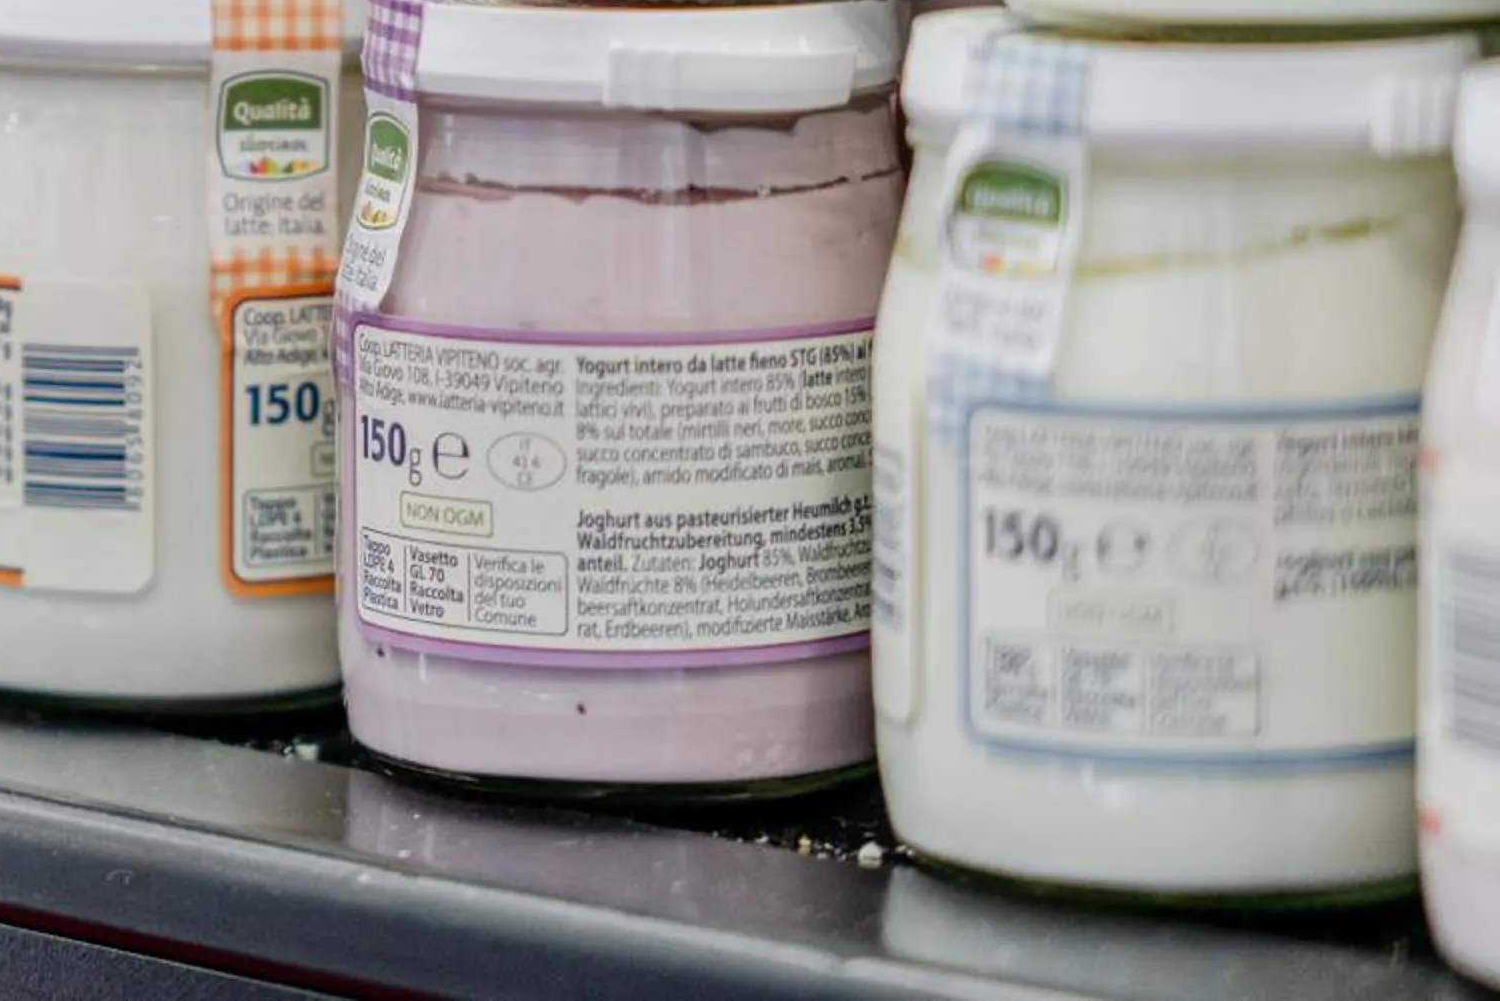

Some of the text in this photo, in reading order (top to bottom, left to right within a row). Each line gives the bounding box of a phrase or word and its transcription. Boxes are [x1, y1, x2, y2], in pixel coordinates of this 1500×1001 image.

[233, 97, 312, 126] Qualità
[222, 192, 325, 217] Origine del
[383, 341, 435, 363] LATTERIA
[576, 355, 630, 380] Yogurt
[634, 353, 683, 375] intero
[686, 353, 707, 374] da
[710, 352, 747, 373] latte
[749, 350, 788, 370] fieno
[789, 346, 817, 368] STG
[492, 373, 565, 398] Vipiteno
[667, 378, 717, 400] Yogurt
[245, 381, 321, 427] 150
[361, 414, 407, 467] 150
[408, 447, 423, 487] g
[623, 445, 715, 463] concentrato
[406, 502, 485, 527] NON OGM
[577, 509, 641, 533] Joghurt
[644, 513, 673, 529] aus
[676, 504, 789, 532] pasteurisierter
[770, 522, 847, 545] mindestens
[409, 545, 459, 568] Vasetto
[473, 553, 545, 574] Verifica le
[698, 550, 760, 575] Joghurt
[409, 563, 445, 583] GL 70
[474, 572, 563, 594] disposizioni
[409, 580, 465, 603] Raccolta
[409, 597, 445, 618] Vetro
[474, 606, 538, 628] Comune
